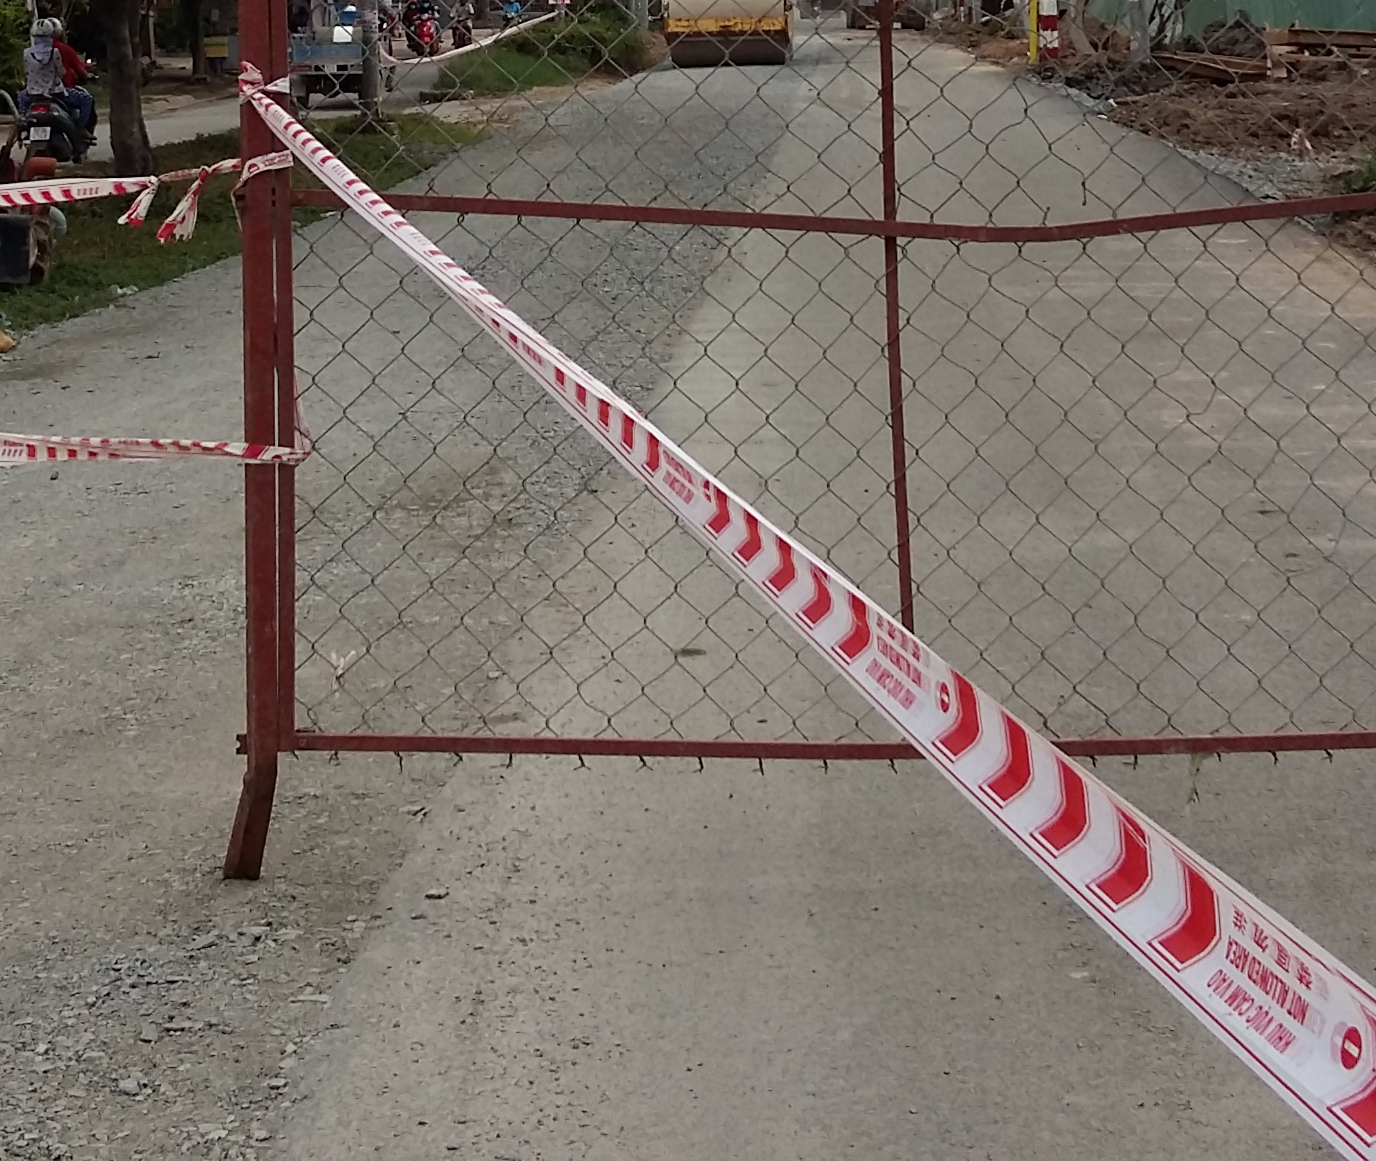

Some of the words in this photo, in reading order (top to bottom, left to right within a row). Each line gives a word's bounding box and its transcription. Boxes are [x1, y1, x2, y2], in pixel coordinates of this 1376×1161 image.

[1224, 935, 1251, 975] AREA
[1246, 956, 1291, 1009] ALLOWED
[1286, 991, 1310, 1027] NOT
[1264, 1022, 1297, 1055] KHU
